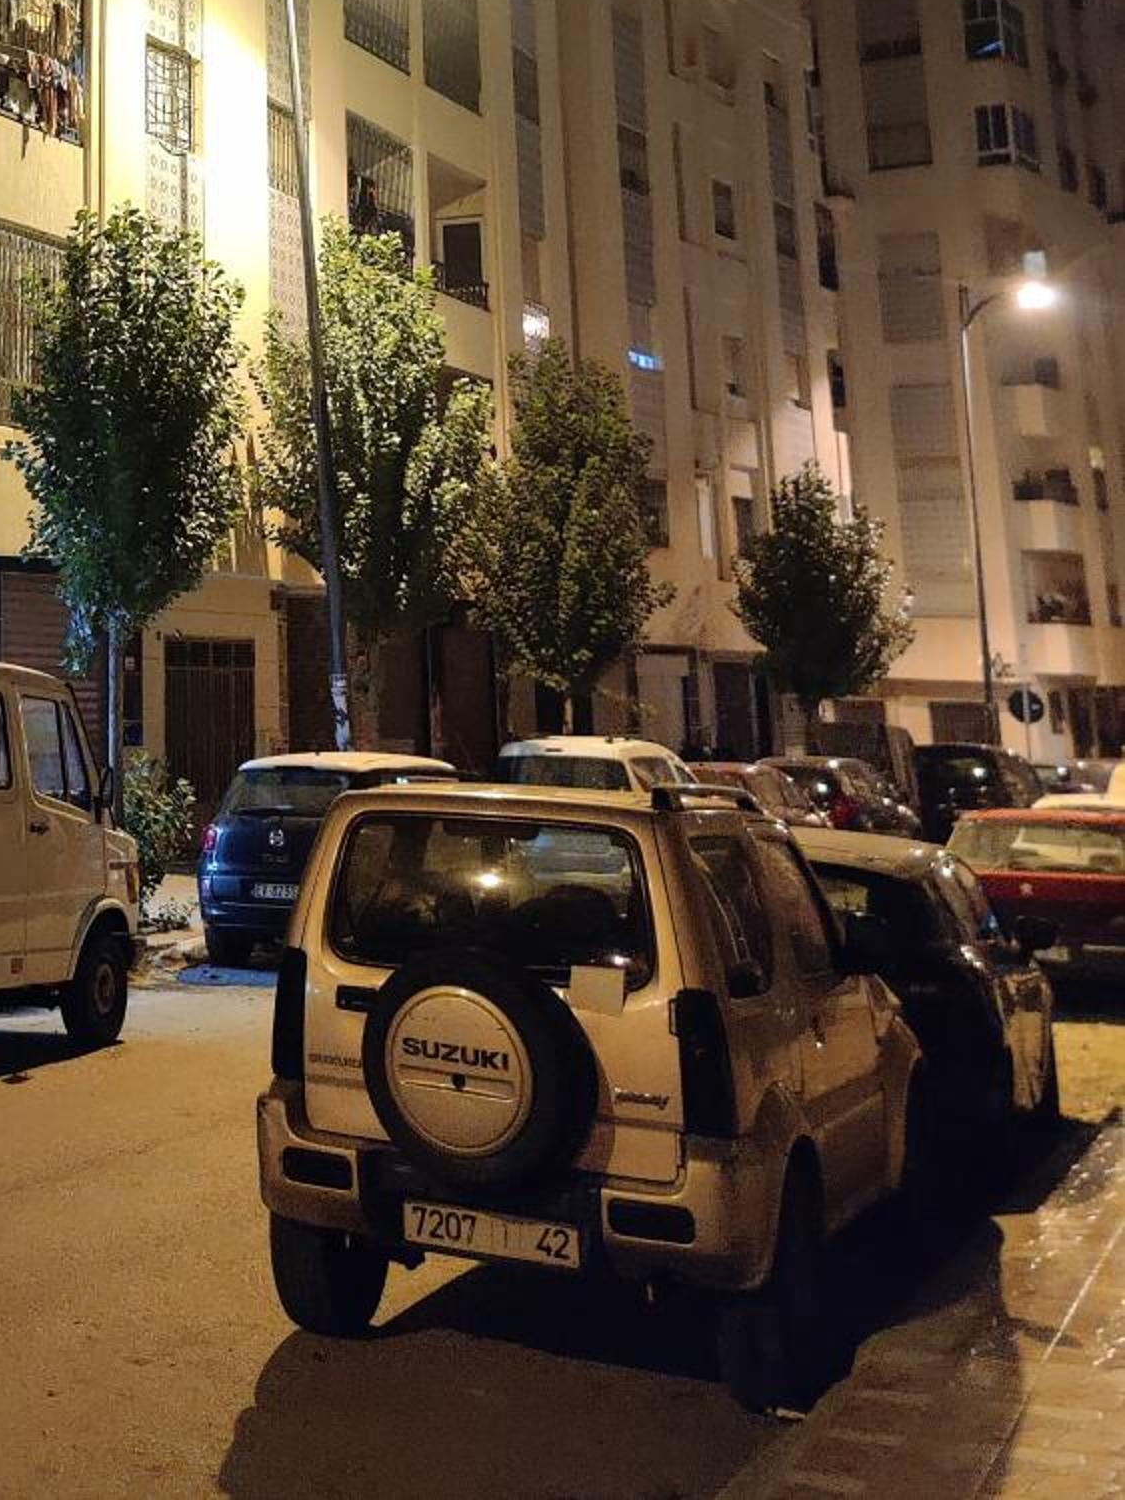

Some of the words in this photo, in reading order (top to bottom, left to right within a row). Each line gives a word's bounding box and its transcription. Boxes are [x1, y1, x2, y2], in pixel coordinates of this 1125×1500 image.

[402, 1037, 509, 1072] SUZUKI
[412, 1206, 477, 1244] 7207
[536, 1227, 571, 1260] 42
